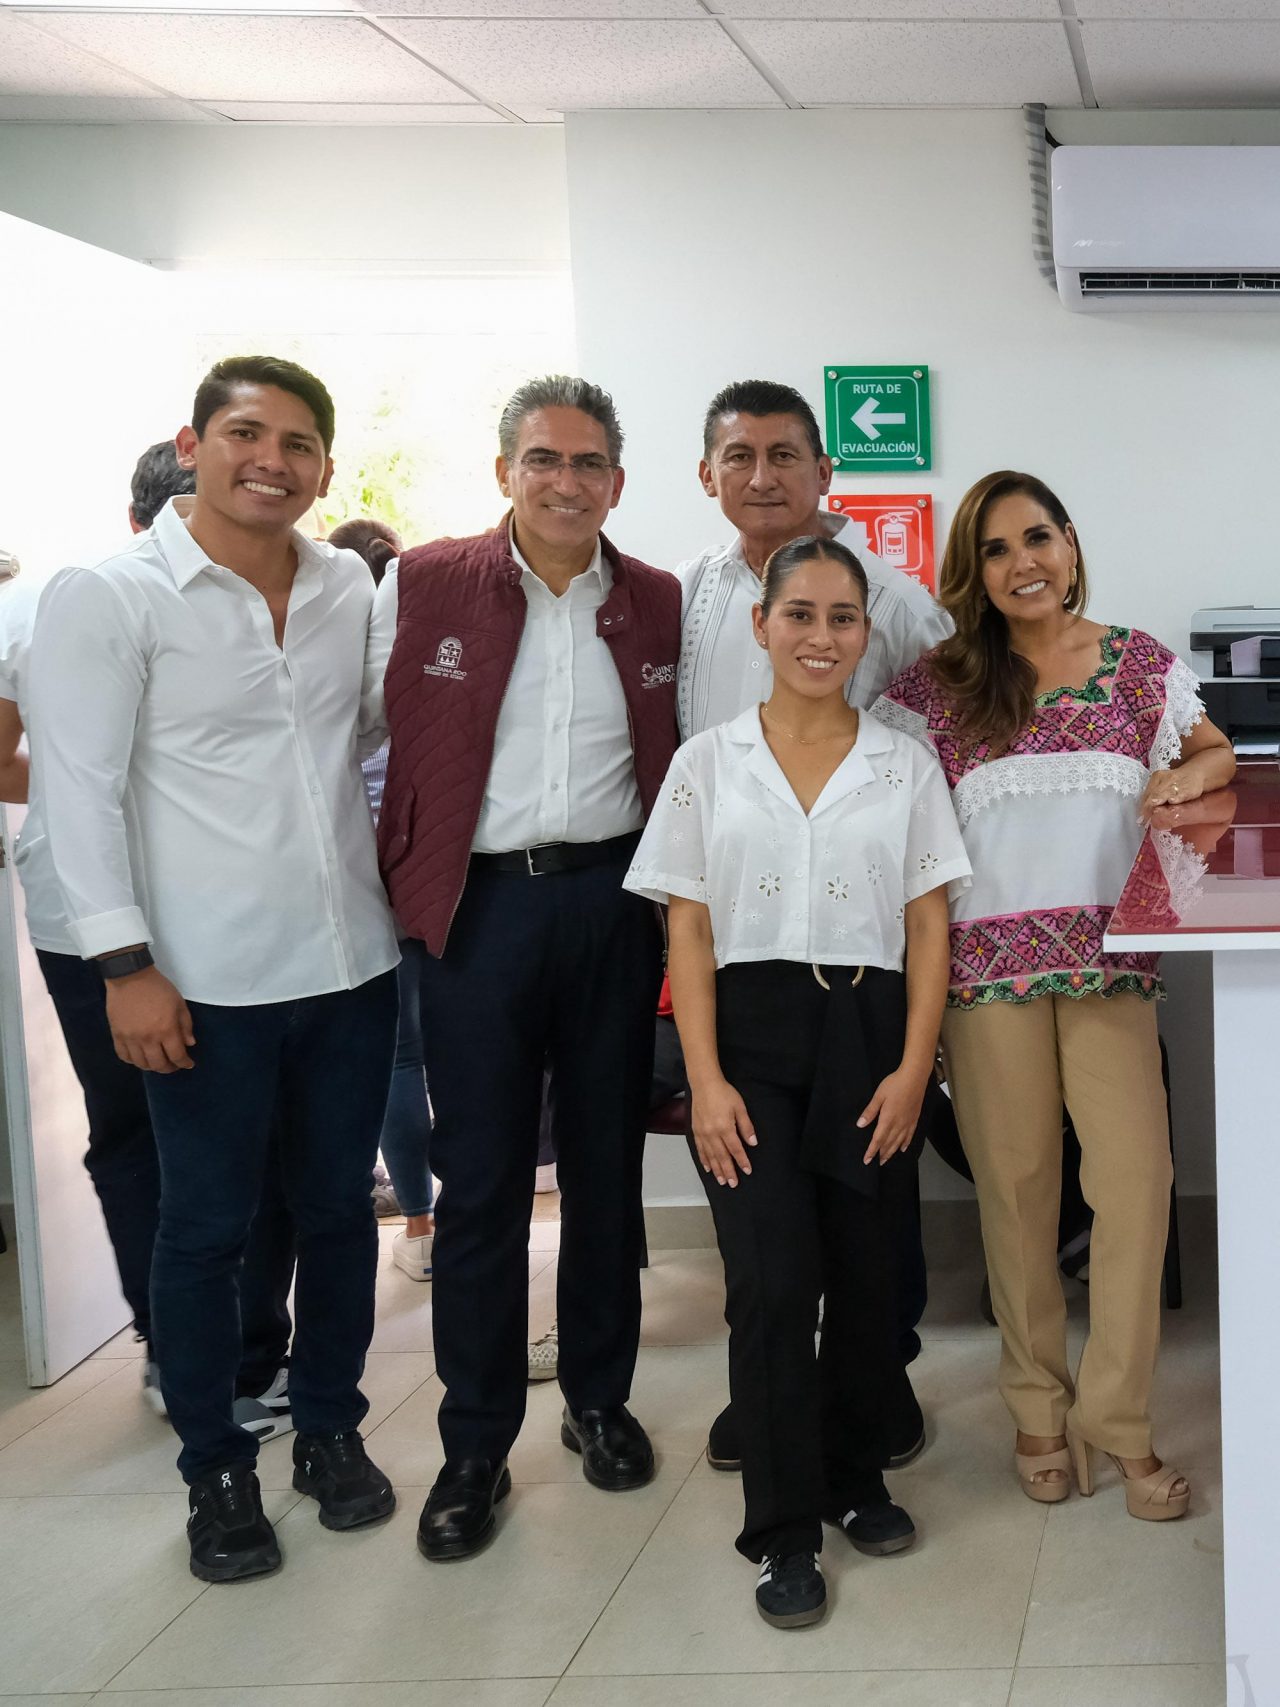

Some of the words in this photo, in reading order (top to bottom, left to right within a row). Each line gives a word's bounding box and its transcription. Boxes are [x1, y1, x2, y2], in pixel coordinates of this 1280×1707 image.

[853, 384, 884, 394] RUTA
[886, 384, 902, 394] DE
[841, 441, 916, 454] EVACUACIÓN
[453, 669, 467, 677] ROO
